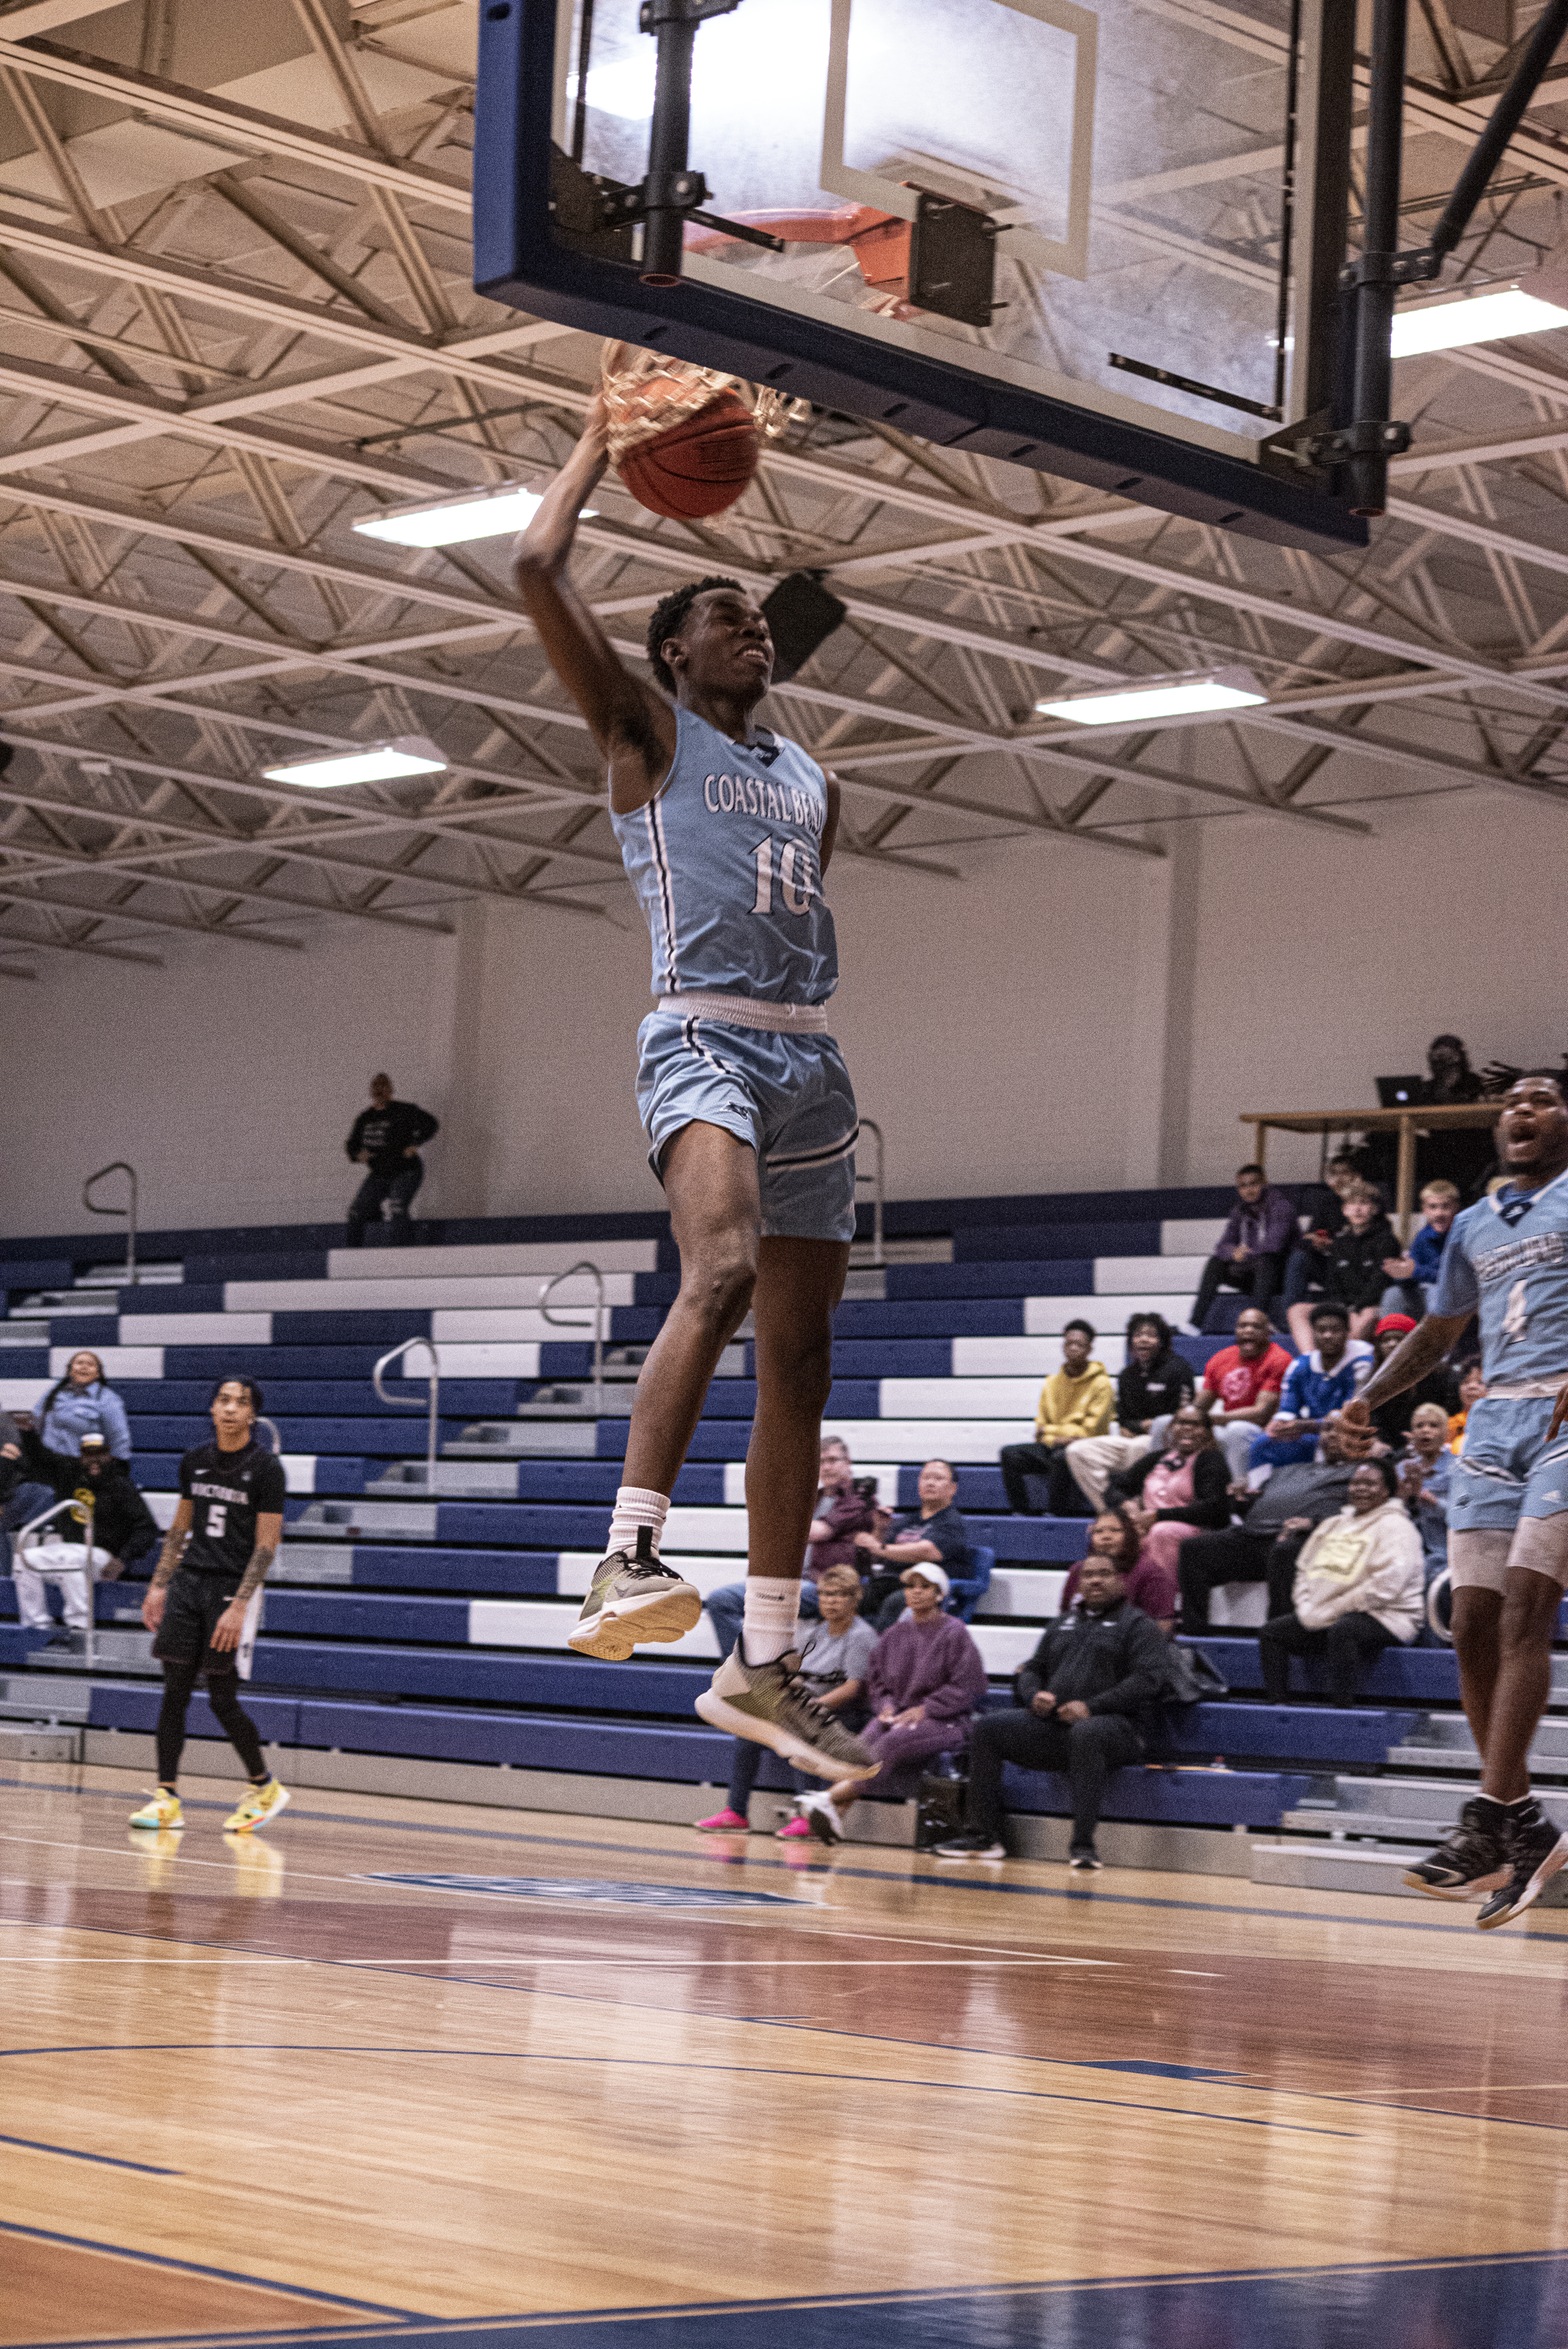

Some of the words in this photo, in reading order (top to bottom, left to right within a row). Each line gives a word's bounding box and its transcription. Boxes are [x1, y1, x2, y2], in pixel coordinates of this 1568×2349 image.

[703, 773, 792, 823] COASTAL
[748, 834, 814, 917] 10
[205, 1504, 228, 1538] 5
